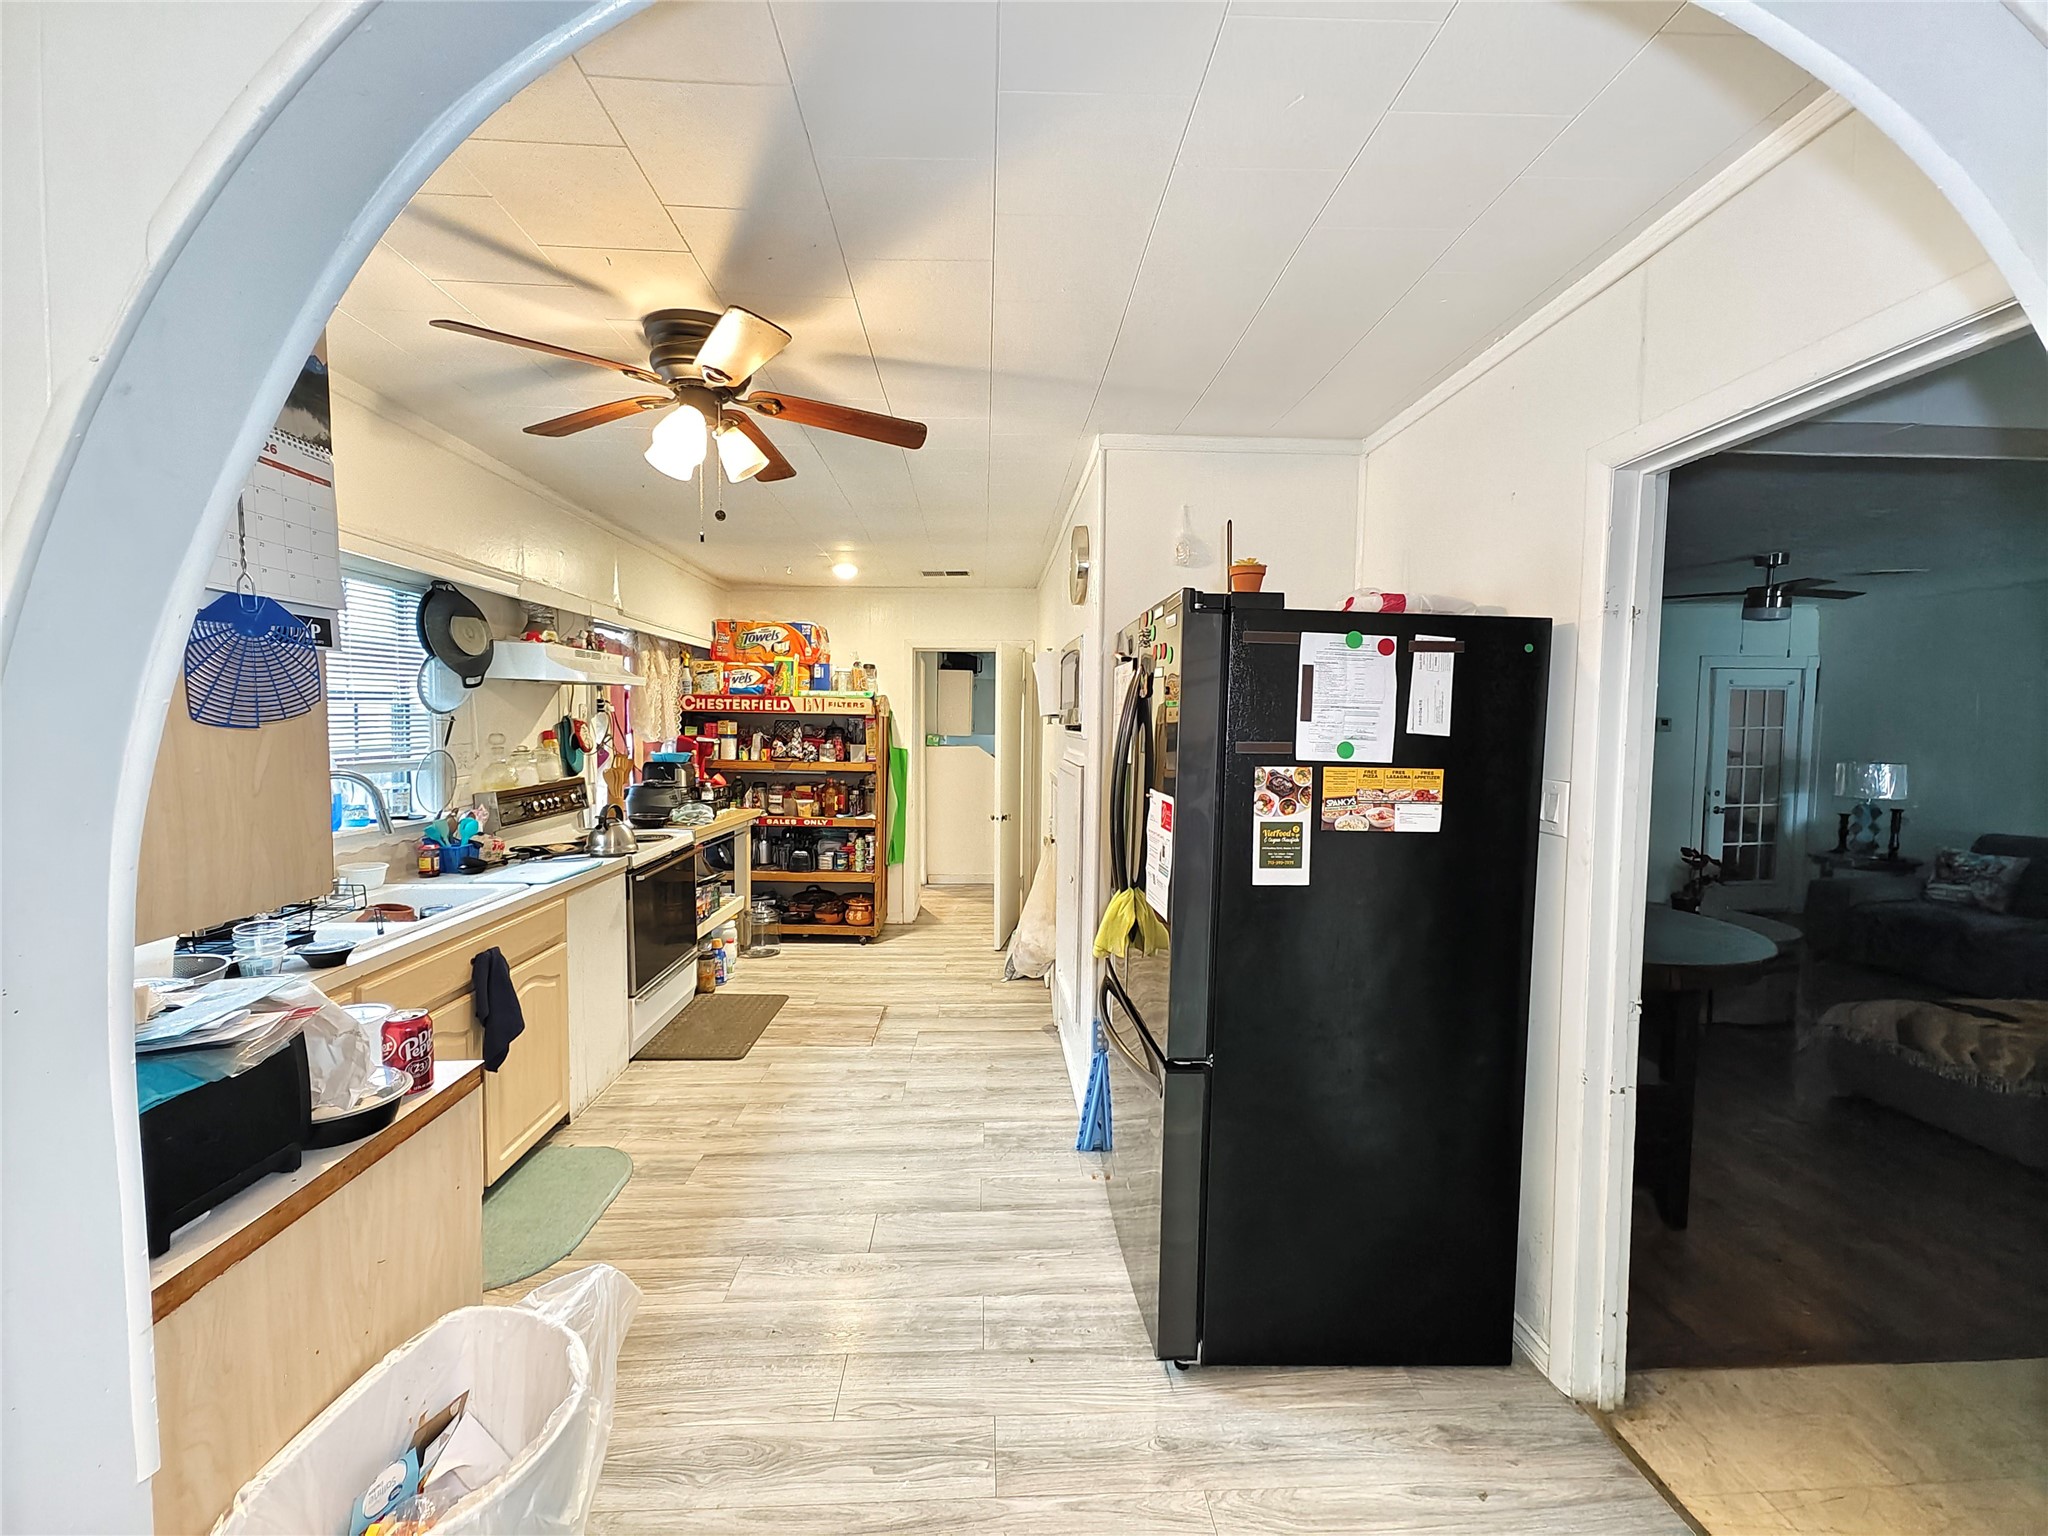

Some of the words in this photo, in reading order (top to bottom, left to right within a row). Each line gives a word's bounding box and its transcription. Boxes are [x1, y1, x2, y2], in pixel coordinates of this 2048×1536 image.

[742, 629, 779, 645] Towels
[731, 672, 753, 684] wels
[682, 694, 791, 711] CHESTERFIELD
[1325, 796, 1357, 807] SPANKY'S
[399, 1037, 432, 1061] Pepp
[413, 1062, 425, 1073] 23
